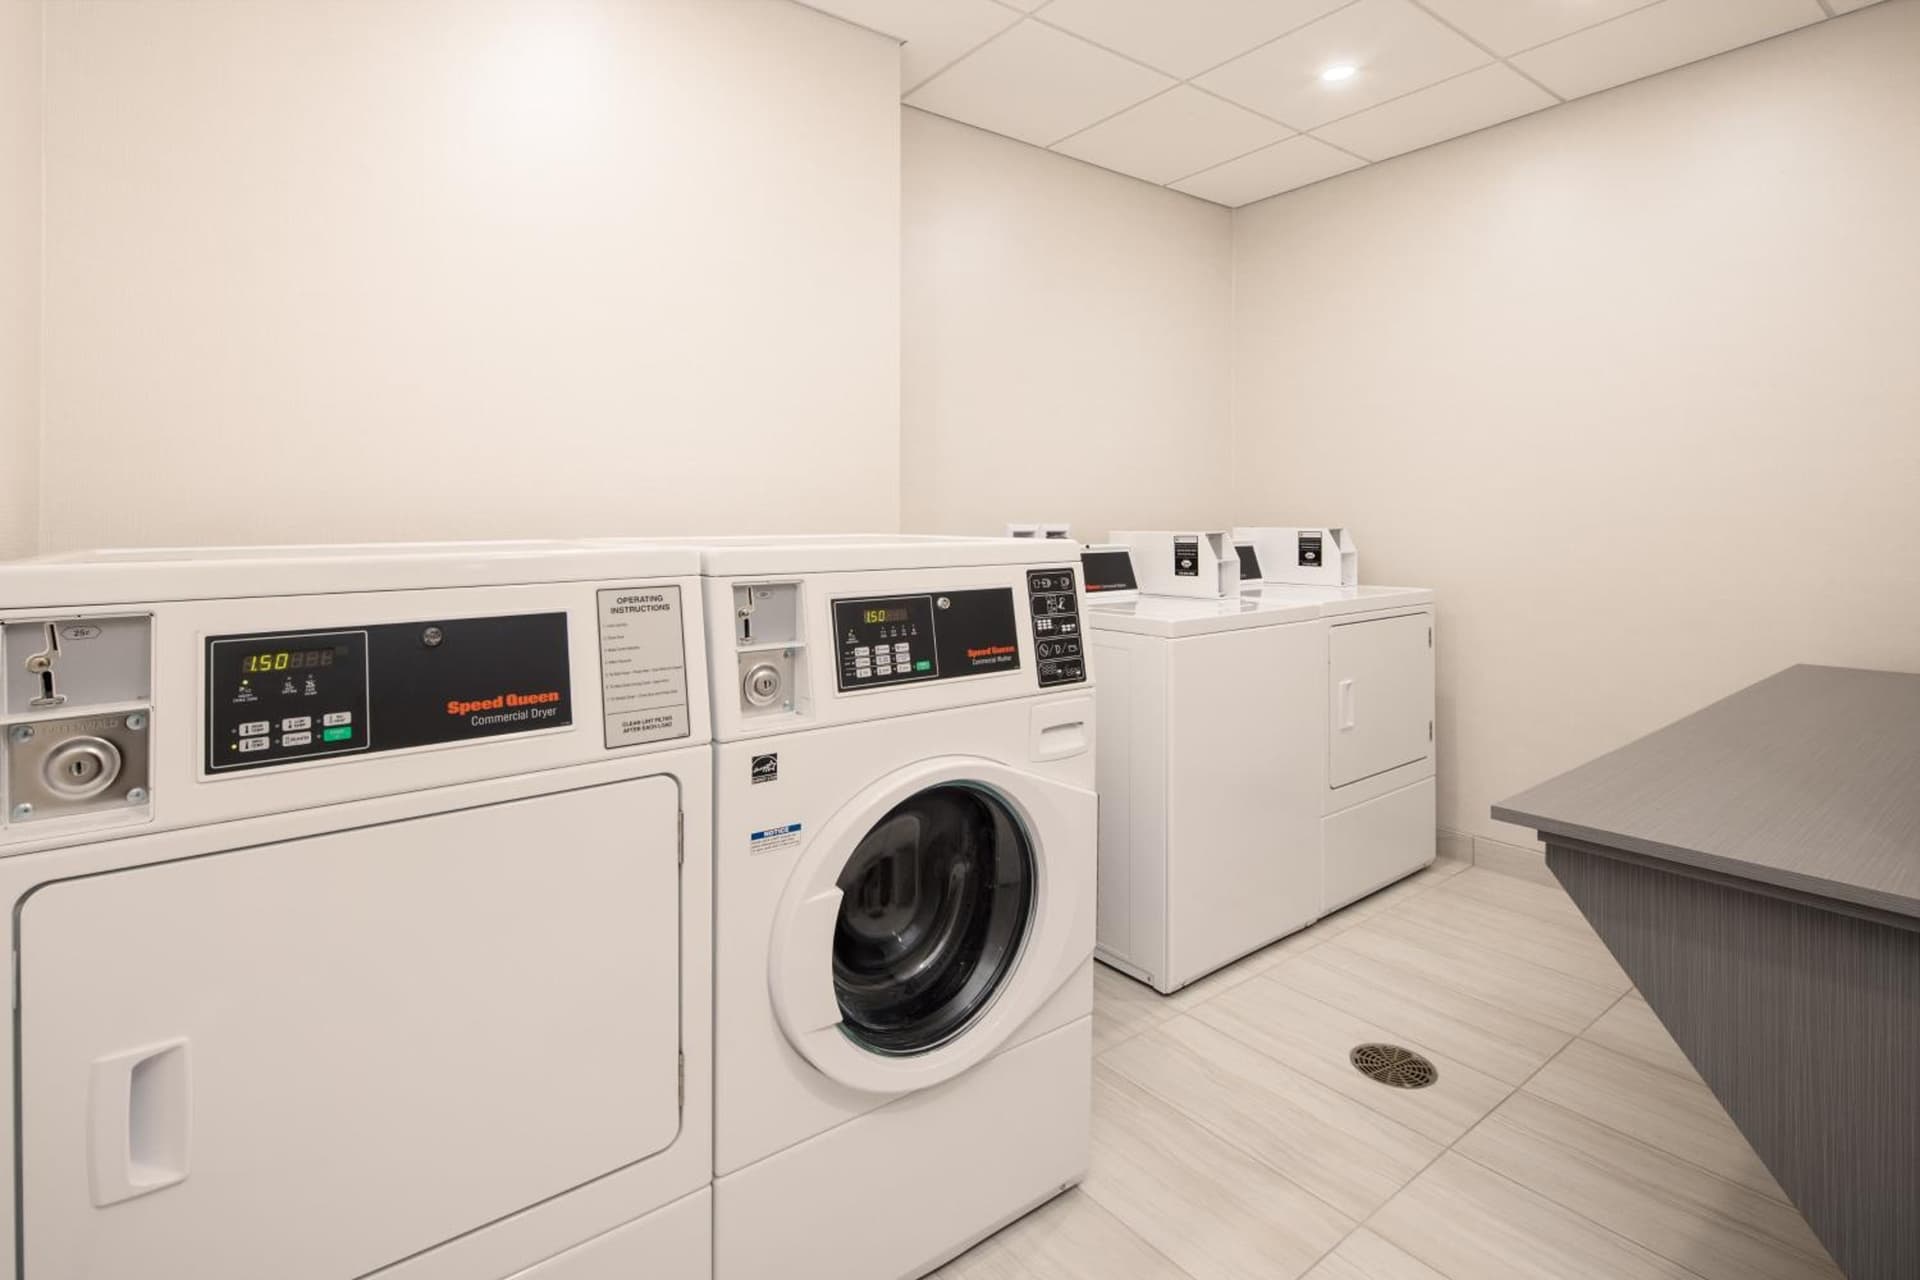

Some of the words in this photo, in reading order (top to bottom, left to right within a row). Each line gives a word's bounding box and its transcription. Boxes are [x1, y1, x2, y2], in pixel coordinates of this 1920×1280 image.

[616, 594, 663, 604] OPERATING
[610, 603, 671, 614] INSTRUCTIONS
[250, 652, 289, 672] 1.50
[447, 695, 504, 716] Speed
[505, 691, 560, 707] Queen
[471, 709, 529, 727] Commercial
[531, 706, 558, 720] Dryer
[763, 826, 788, 837] NOTICE
